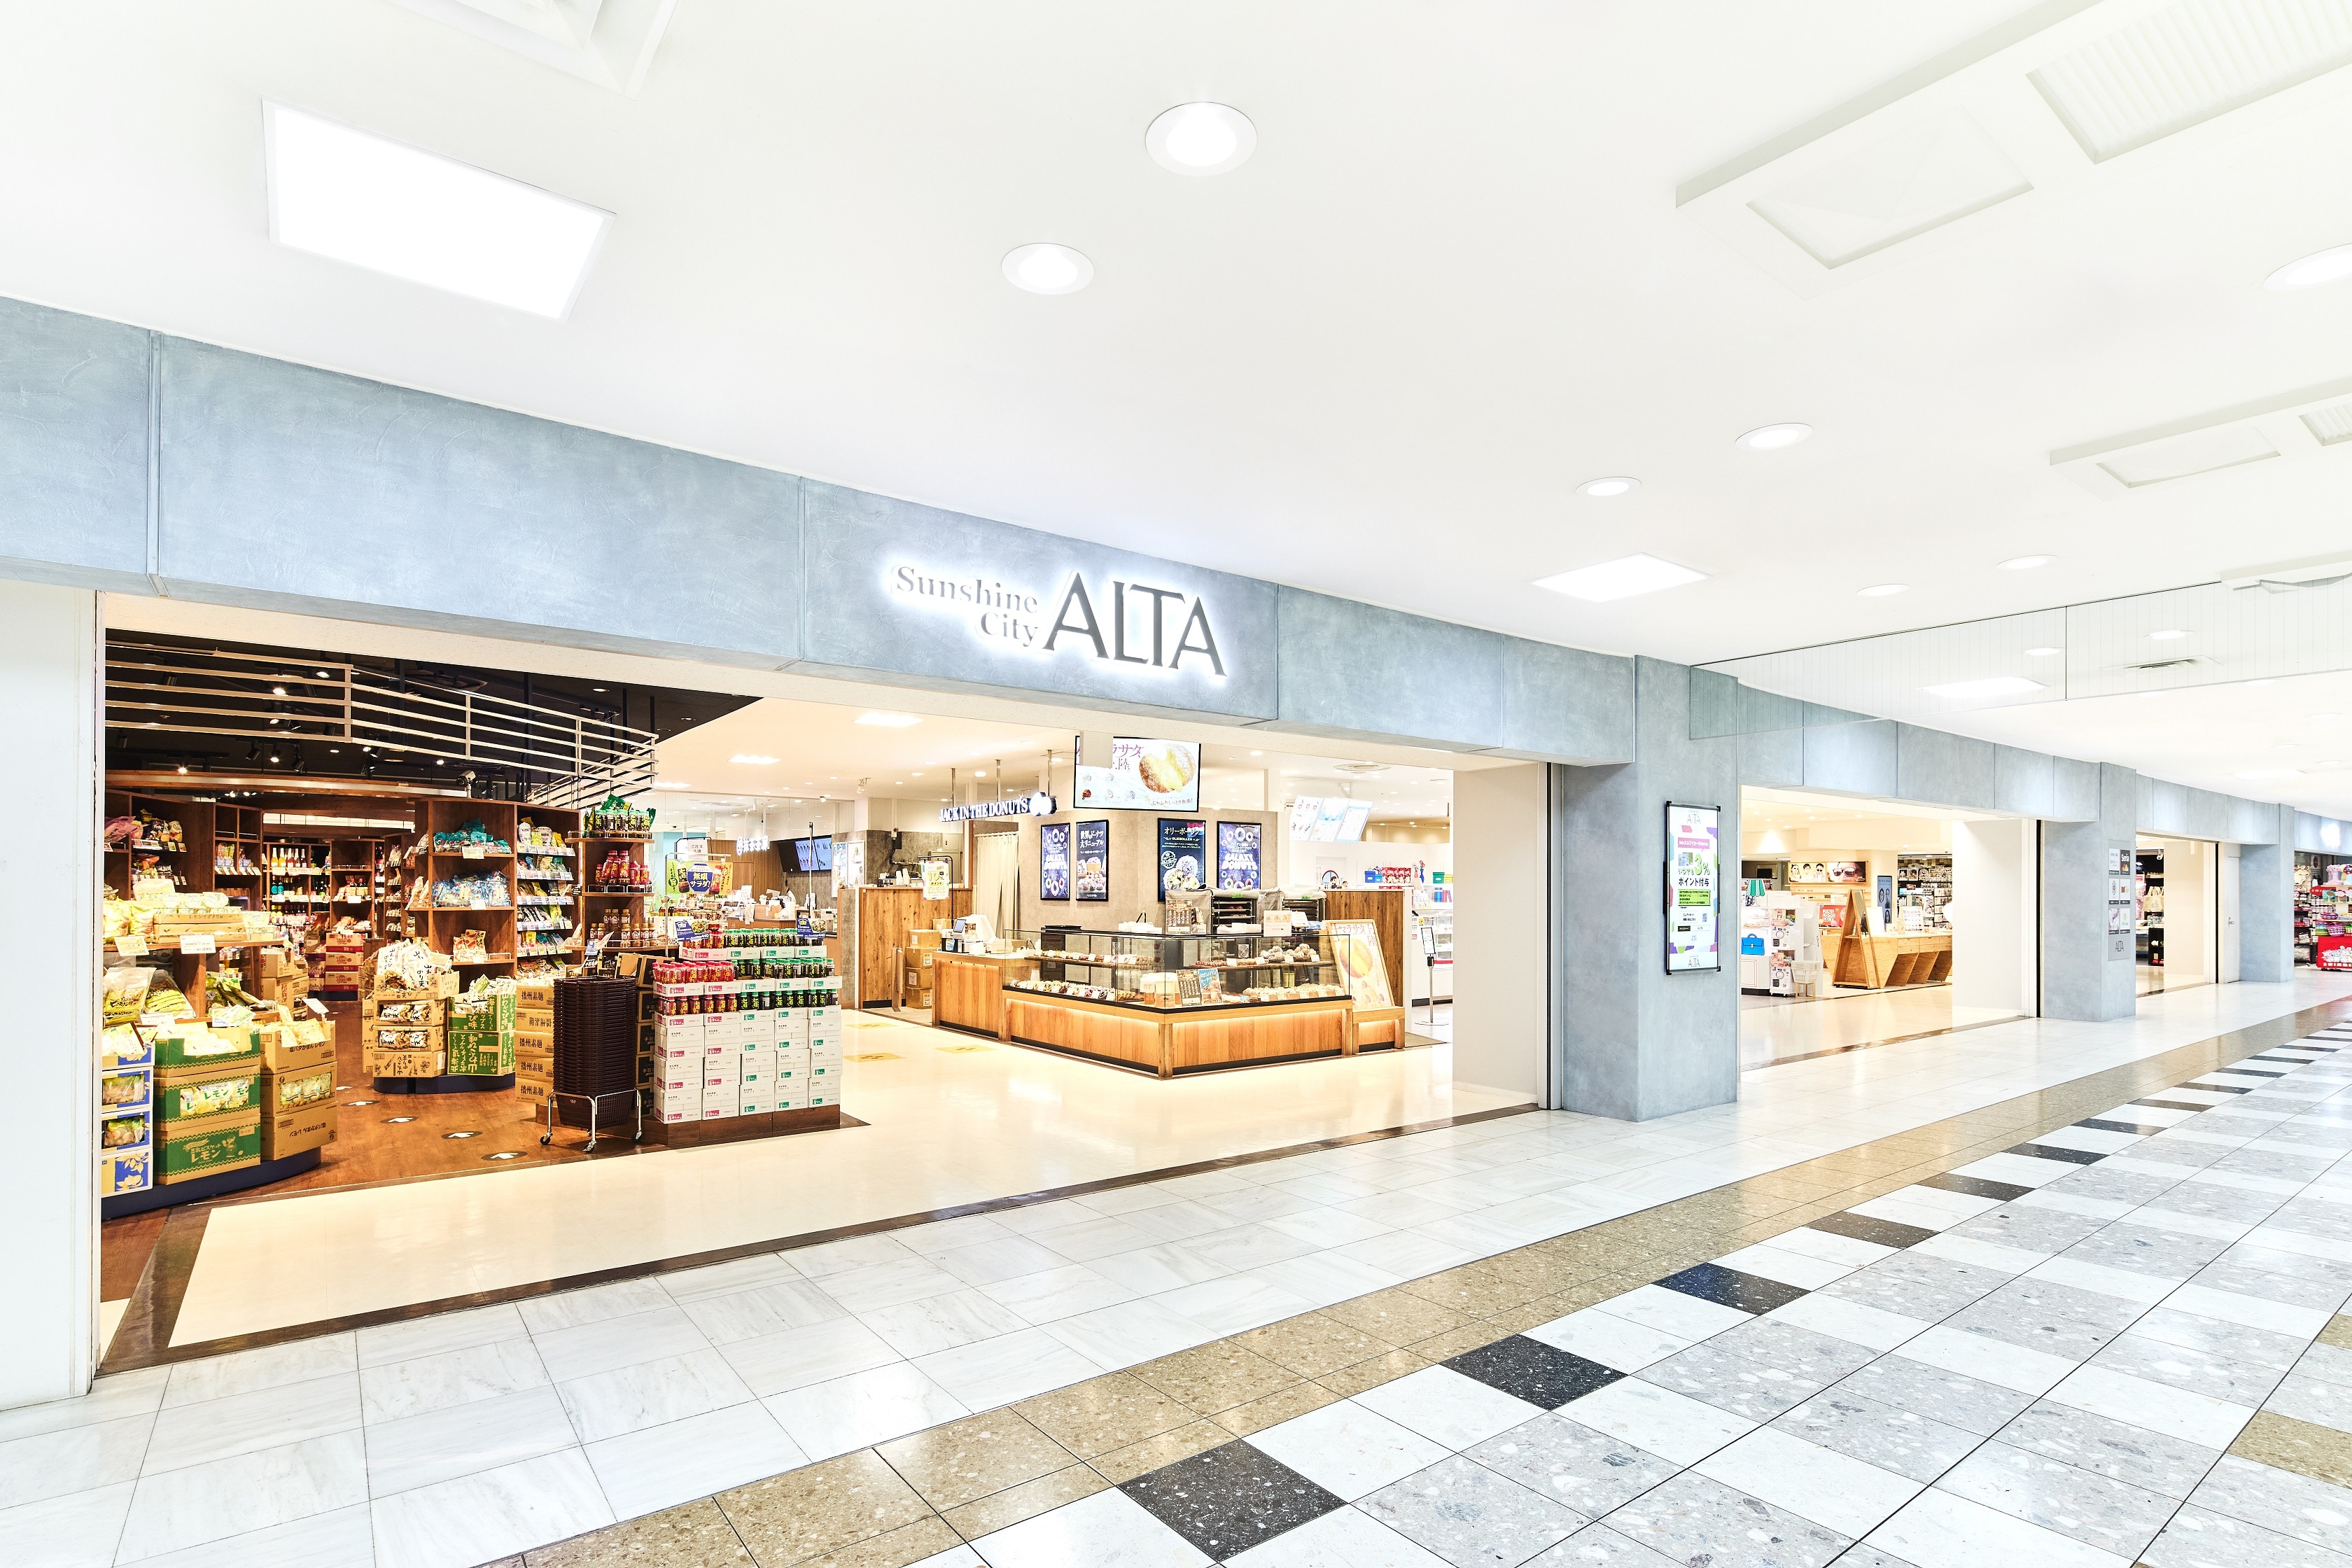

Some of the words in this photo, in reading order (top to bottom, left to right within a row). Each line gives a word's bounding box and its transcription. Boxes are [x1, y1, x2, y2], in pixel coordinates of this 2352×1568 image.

[896, 566, 1038, 615] Sunshine
[979, 611, 1040, 648] City
[1042, 571, 1228, 678] ALTA
[969, 803, 988, 819] THE
[694, 872, 708, 881] 無限
[1678, 877, 1709, 887] ポイント付与
[522, 990, 544, 1001] 播州素麺
[519, 1037, 542, 1049] 播州素麺
[521, 1061, 543, 1072] 播州素麺
[204, 1089, 229, 1102] レモン
[521, 1084, 544, 1096] 播州素麺
[190, 1149, 220, 1163] レモン
